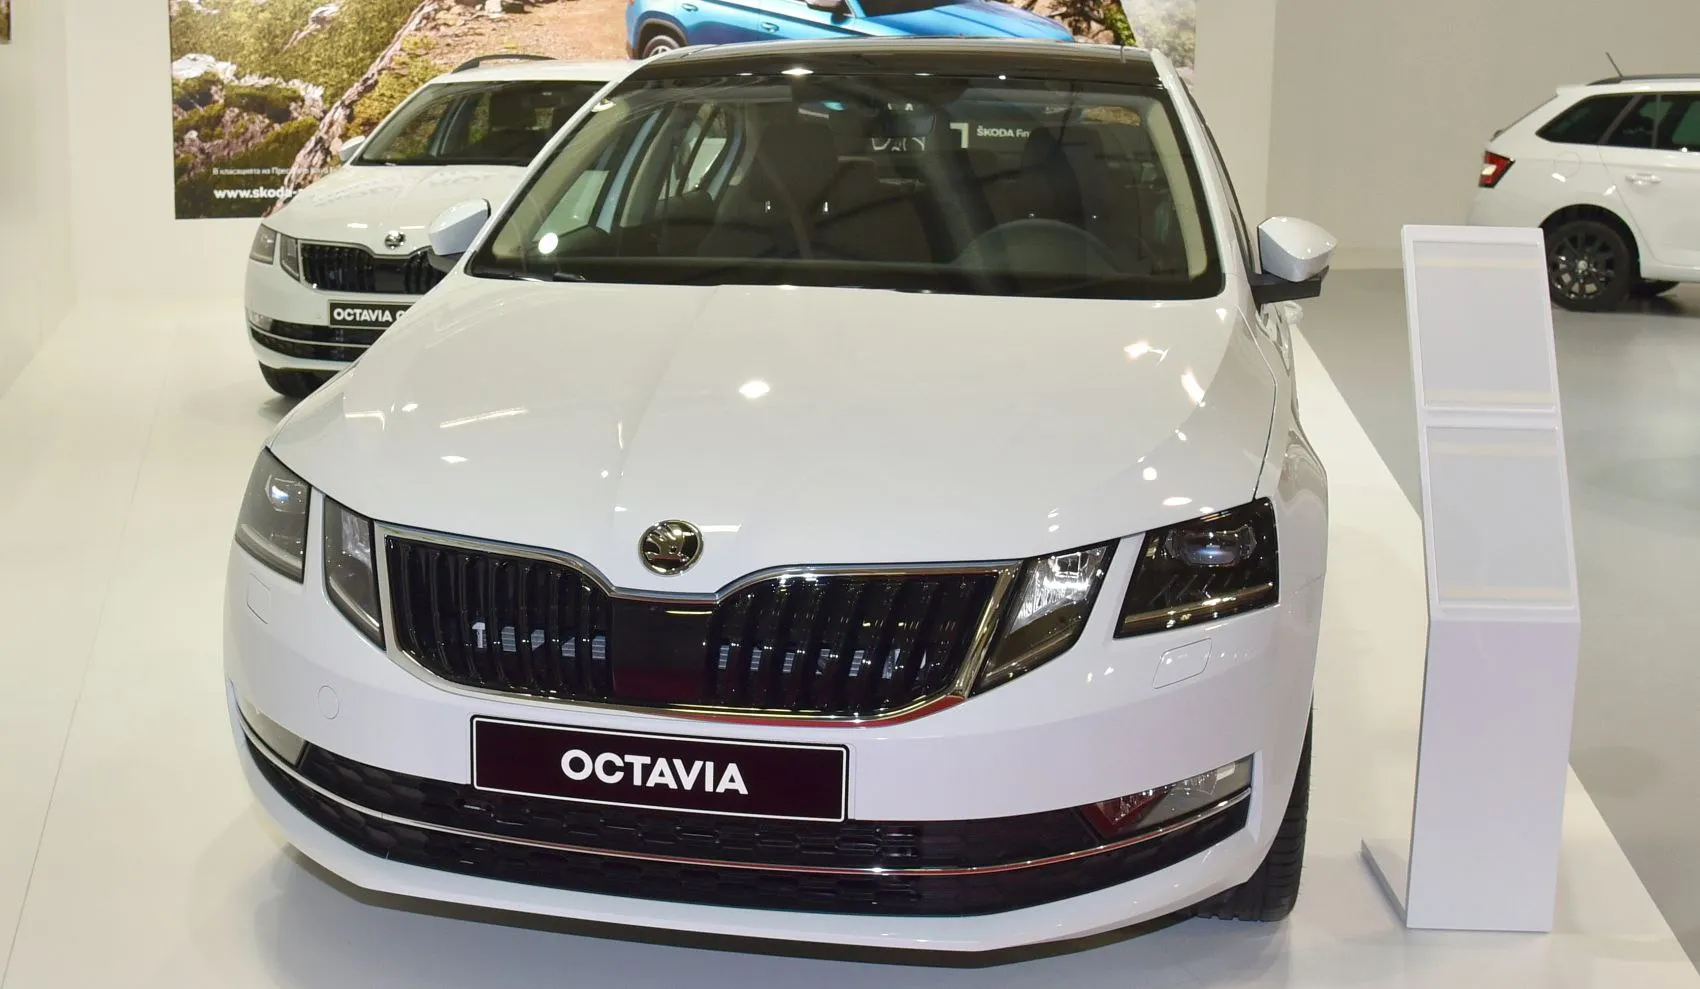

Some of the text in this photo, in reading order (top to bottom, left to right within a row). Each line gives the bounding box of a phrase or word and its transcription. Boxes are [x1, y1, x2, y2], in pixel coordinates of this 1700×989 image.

[976, 125, 1031, 138] ŠKODA Fin
[333, 308, 393, 322] OCTAVIA
[560, 749, 749, 795] OCTAVIA
